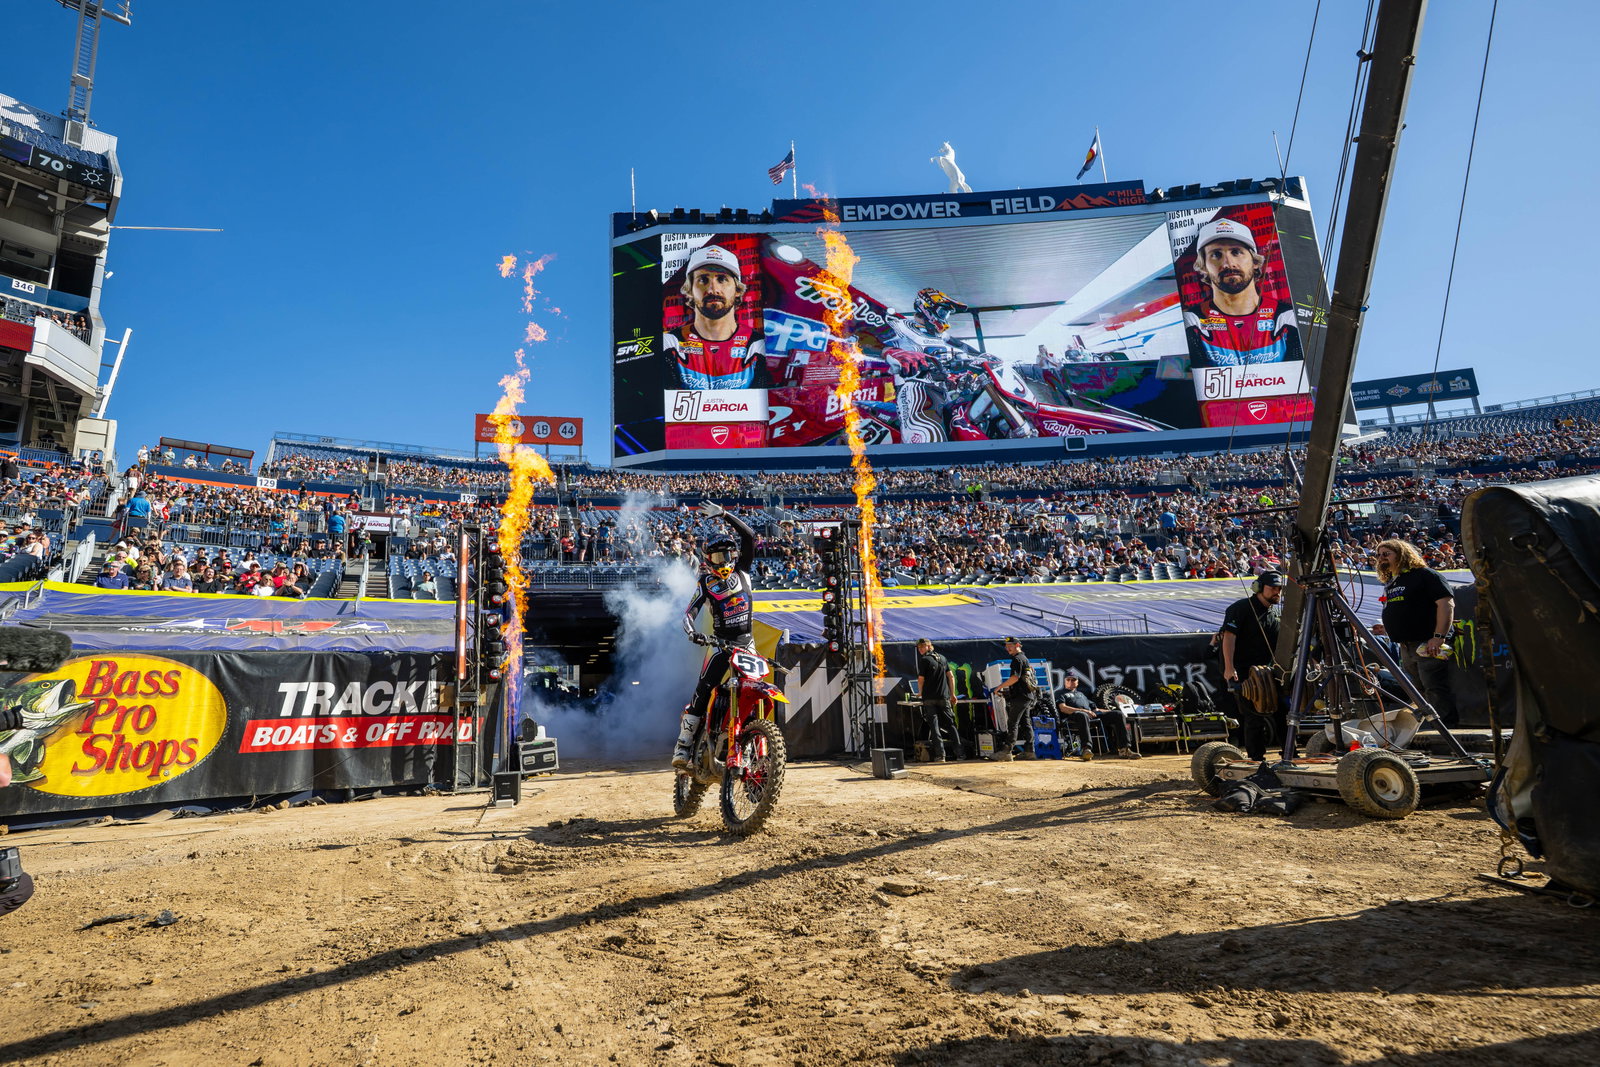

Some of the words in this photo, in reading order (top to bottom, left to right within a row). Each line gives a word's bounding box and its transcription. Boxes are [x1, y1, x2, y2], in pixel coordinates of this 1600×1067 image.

[38, 154, 72, 172] 70°
[1117, 188, 1142, 198] MILE
[1118, 196, 1146, 206] HIGH
[843, 202, 961, 222] EMPOWER
[991, 196, 1056, 216] FIELD
[1168, 209, 1192, 220] JUSTIN
[1170, 218, 1194, 230] BARCIA
[664, 234, 686, 242] JUSTIN
[664, 242, 688, 252] BARCIA
[14, 280, 33, 292] 346
[854, 298, 886, 326] Lee
[616, 340, 652, 356] SMX
[1204, 368, 1232, 398] 51
[1236, 377, 1286, 388] BARCIA
[672, 391, 702, 421] 51
[702, 404, 748, 412] BARCIA
[536, 424, 549, 435] 18
[561, 426, 574, 436] 44
[259, 480, 276, 488] 129
[462, 494, 476, 503] 129
[726, 614, 748, 624] DUCATI
[738, 655, 764, 674] 51
[78, 660, 182, 697] Bass
[1048, 659, 1218, 694] ONSTER
[75, 698, 157, 734] Pro
[251, 724, 338, 746] BOATS
[342, 727, 358, 742] &
[366, 722, 416, 742] OFF
[418, 721, 473, 742] ROAD
[71, 734, 199, 780] Shops
